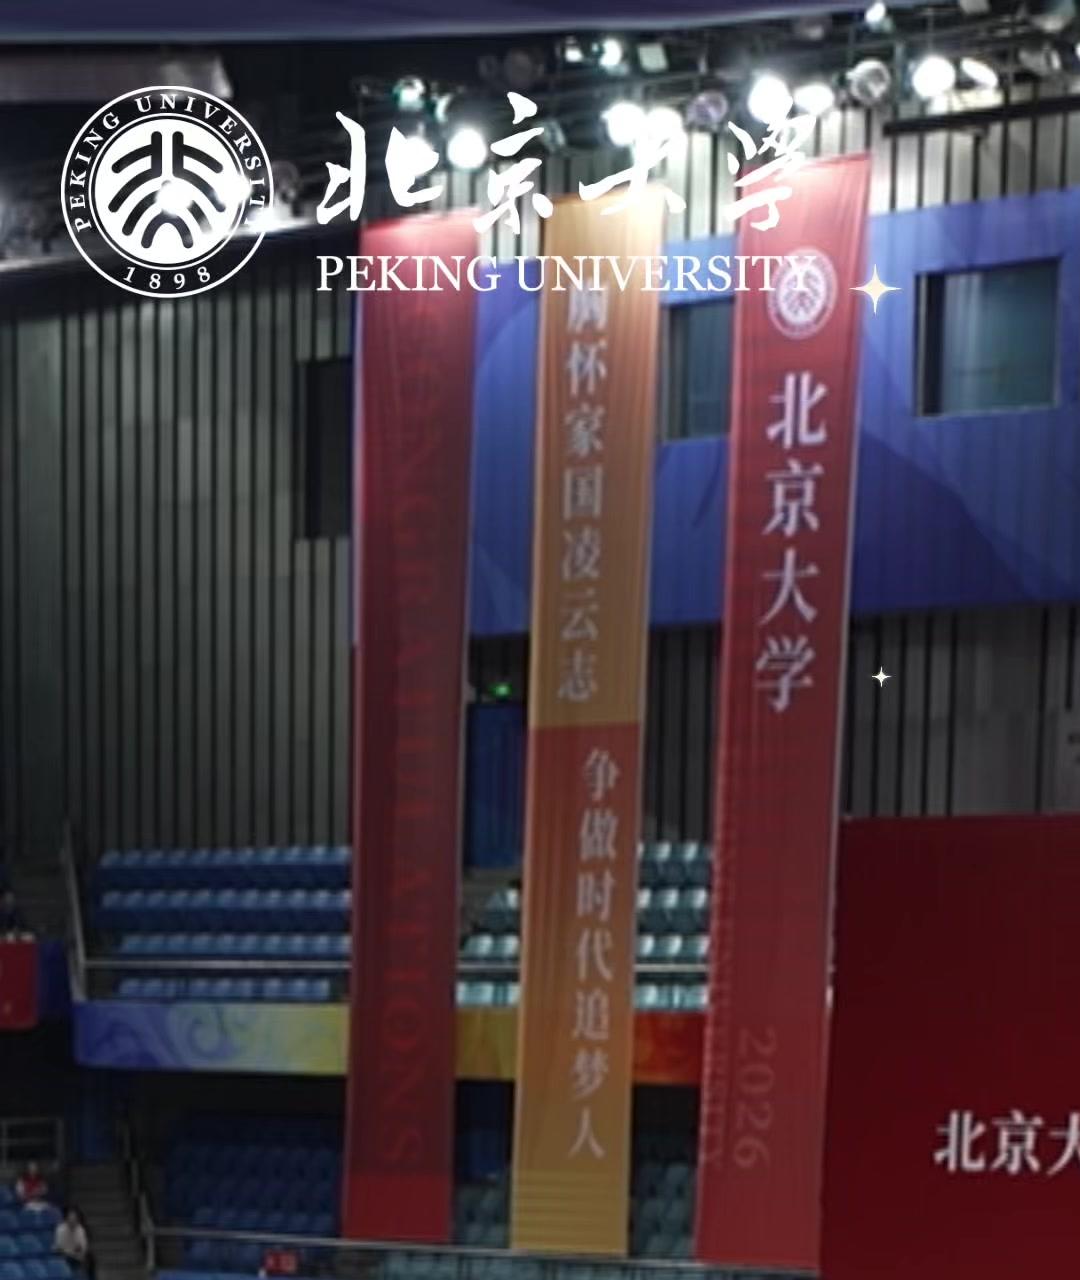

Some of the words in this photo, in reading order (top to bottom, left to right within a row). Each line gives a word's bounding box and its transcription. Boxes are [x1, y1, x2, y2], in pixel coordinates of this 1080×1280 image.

[755, 370, 829, 712] 北京大学
[567, 748, 620, 1160] 争做时代追梦人
[734, 1025, 778, 1168] 2026
